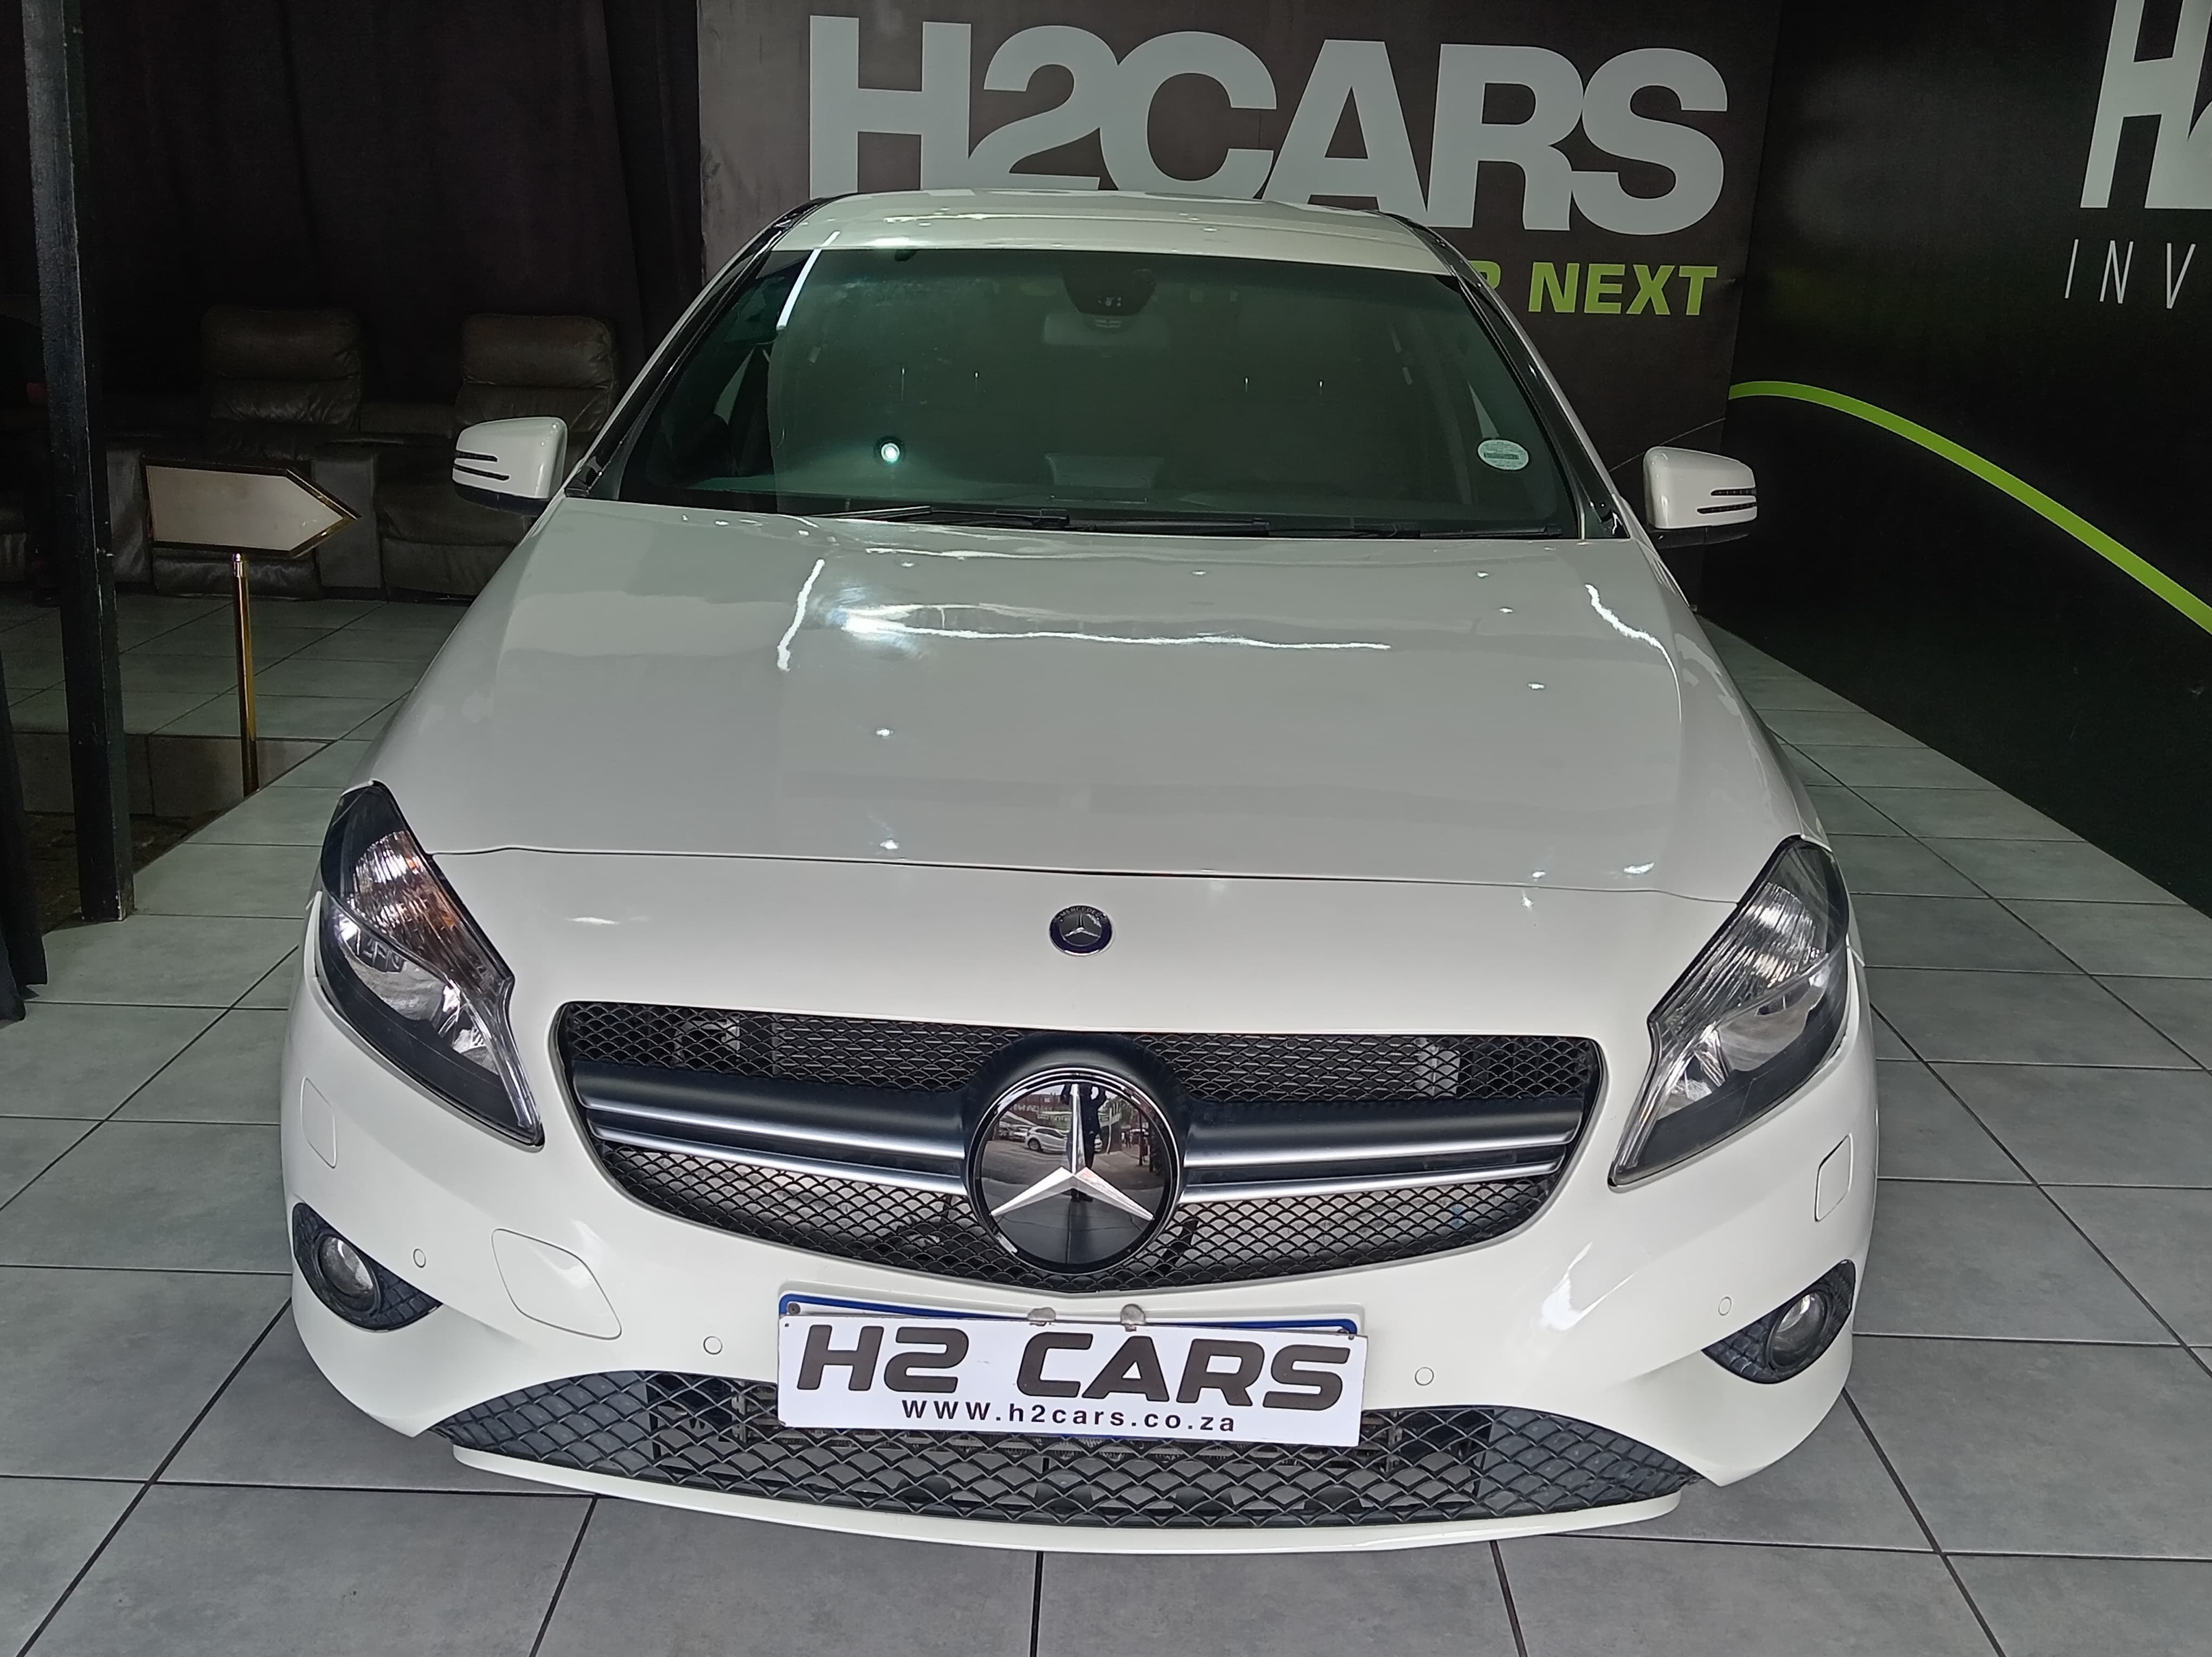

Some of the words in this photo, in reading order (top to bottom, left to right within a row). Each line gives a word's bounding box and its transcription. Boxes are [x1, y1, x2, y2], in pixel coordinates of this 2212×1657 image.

[808, 15, 1728, 236] H2CARS
[1528, 262, 1718, 316] NEXT
[2065, 239, 2196, 309] INV
[796, 1324, 969, 1393] H2
[1015, 1332, 1352, 1411] CARS
[901, 1399, 1236, 1433] www.h2cars.co.za
